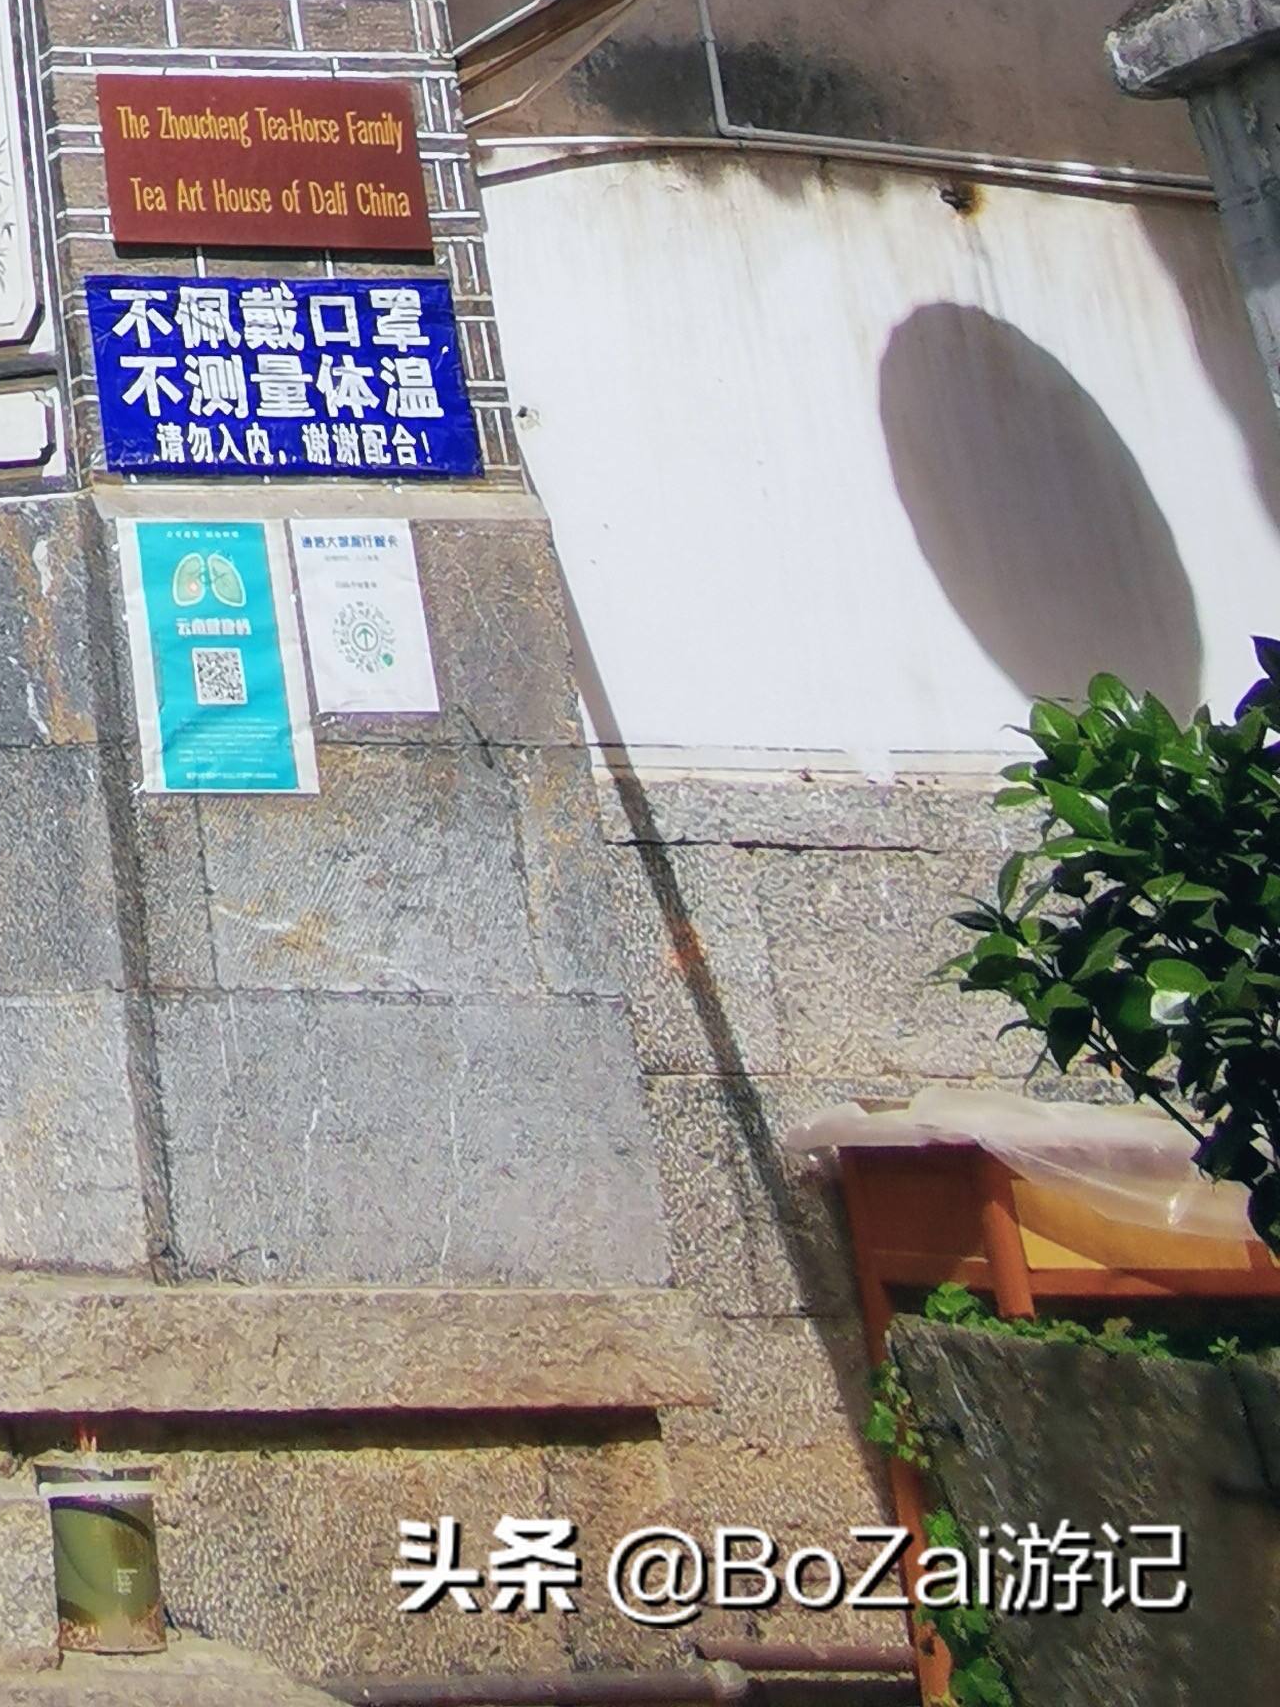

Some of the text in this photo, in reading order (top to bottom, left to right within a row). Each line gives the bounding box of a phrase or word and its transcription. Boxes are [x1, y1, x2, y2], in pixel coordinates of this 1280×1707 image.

[117, 106, 403, 153] The Zhoucheng Tea-Horse Family
[130, 177, 411, 218] Tea Art House of Dali China
[110, 283, 430, 351] 不佩戴口罩
[119, 354, 444, 419] 不测量体温
